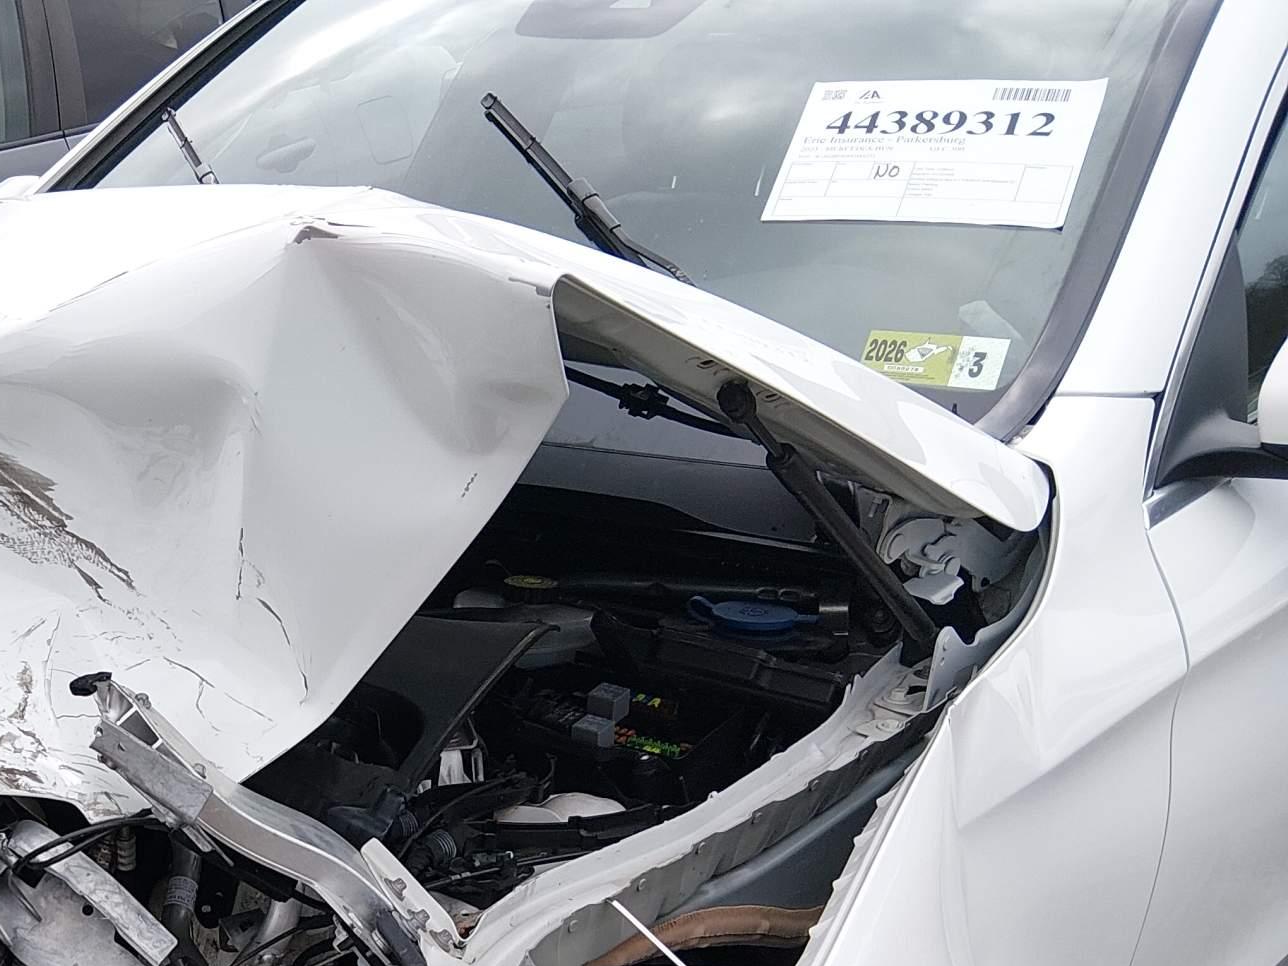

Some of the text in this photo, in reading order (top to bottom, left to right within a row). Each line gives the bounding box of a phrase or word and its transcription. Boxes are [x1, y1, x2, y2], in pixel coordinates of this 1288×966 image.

[825, 110, 1056, 136] 44389312
[830, 135, 885, 144] Insurance
[895, 136, 966, 145] Parkersburg
[864, 338, 907, 363] 2026
[968, 352, 988, 378] 3
